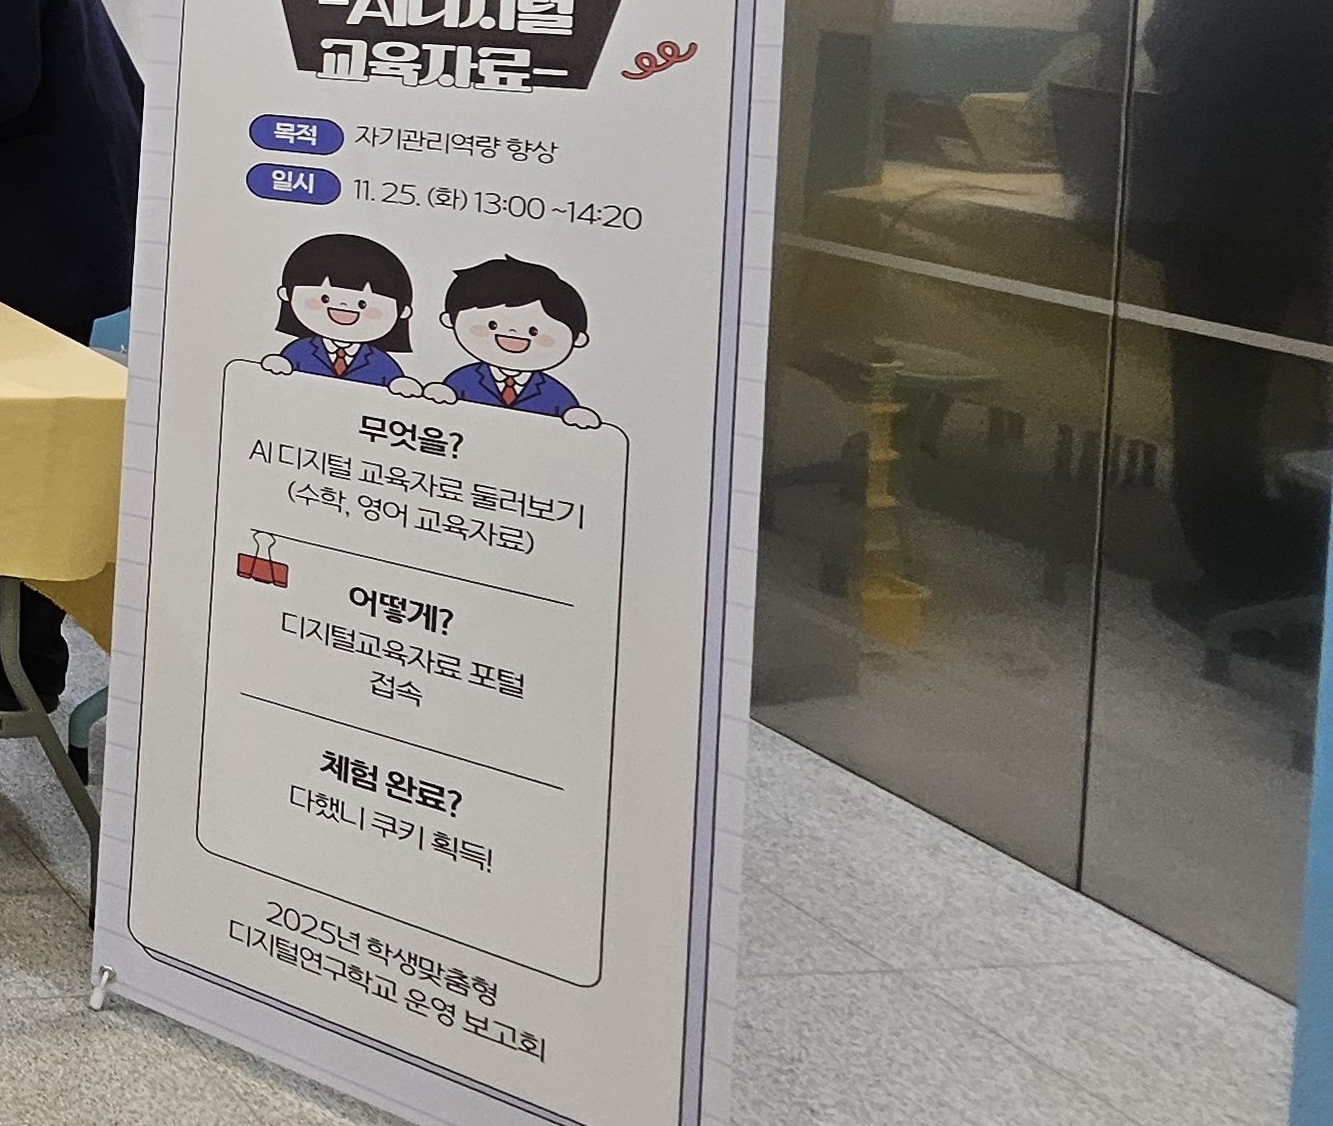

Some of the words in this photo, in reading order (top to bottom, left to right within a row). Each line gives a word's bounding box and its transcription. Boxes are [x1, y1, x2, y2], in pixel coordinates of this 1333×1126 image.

[273, 122, 318, 147] 목적
[354, 124, 502, 159] 자기관리역량
[506, 137, 560, 166] 향상
[271, 169, 316, 194] 일시
[426, 185, 469, 212] (화)
[474, 191, 546, 221] 13:00
[358, 415, 465, 459] 무엇을?
[249, 438, 273, 463] AI
[278, 443, 353, 482] 디지털
[358, 460, 464, 505] 교육자료
[470, 483, 586, 530] 둘러보기
[287, 479, 351, 518] (수학,
[356, 494, 408, 529] 영어
[414, 507, 536, 555] 교육자료)
[348, 585, 455, 637] 어떻게?
[281, 611, 463, 682] 디지털교육자료
[470, 661, 525, 700] 포털
[369, 672, 423, 707] 접속
[319, 749, 379, 794] 체험
[384, 770, 463, 819] 완료?
[289, 784, 366, 831] 다했니
[371, 810, 425, 852] 쿠키
[430, 830, 493, 874] 획득!
[266, 900, 362, 957] 2025년
[366, 935, 499, 1008] 학생맞춤형
[229, 919, 398, 1002] 디지털연구학교
[404, 988, 456, 1026] 운영
[463, 1010, 547, 1063] 보고회
